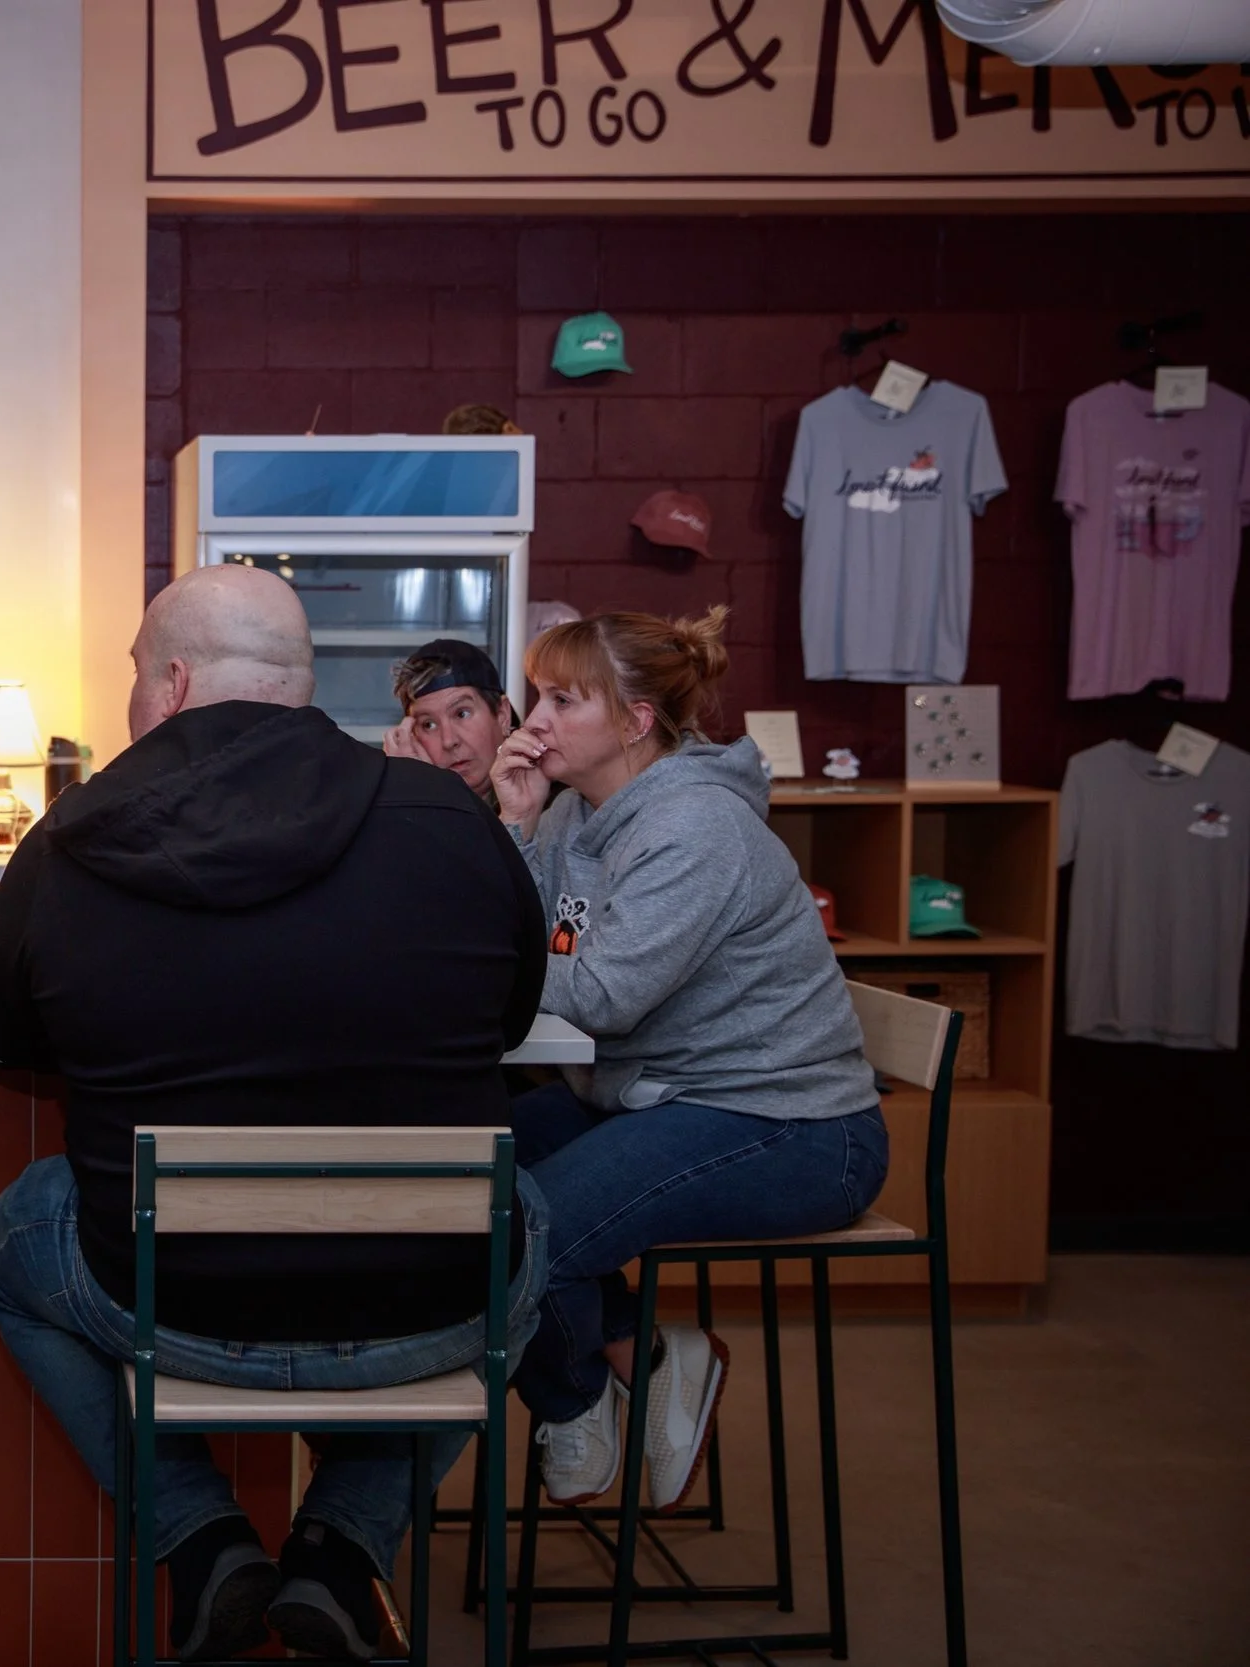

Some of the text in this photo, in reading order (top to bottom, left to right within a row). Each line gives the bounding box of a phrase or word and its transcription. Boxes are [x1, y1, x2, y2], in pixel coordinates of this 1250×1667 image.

[196, 0, 636, 156] BEER
[676, 0, 782, 98] &
[475, 85, 667, 152] TO GO
[1135, 87, 1217, 147] TO
